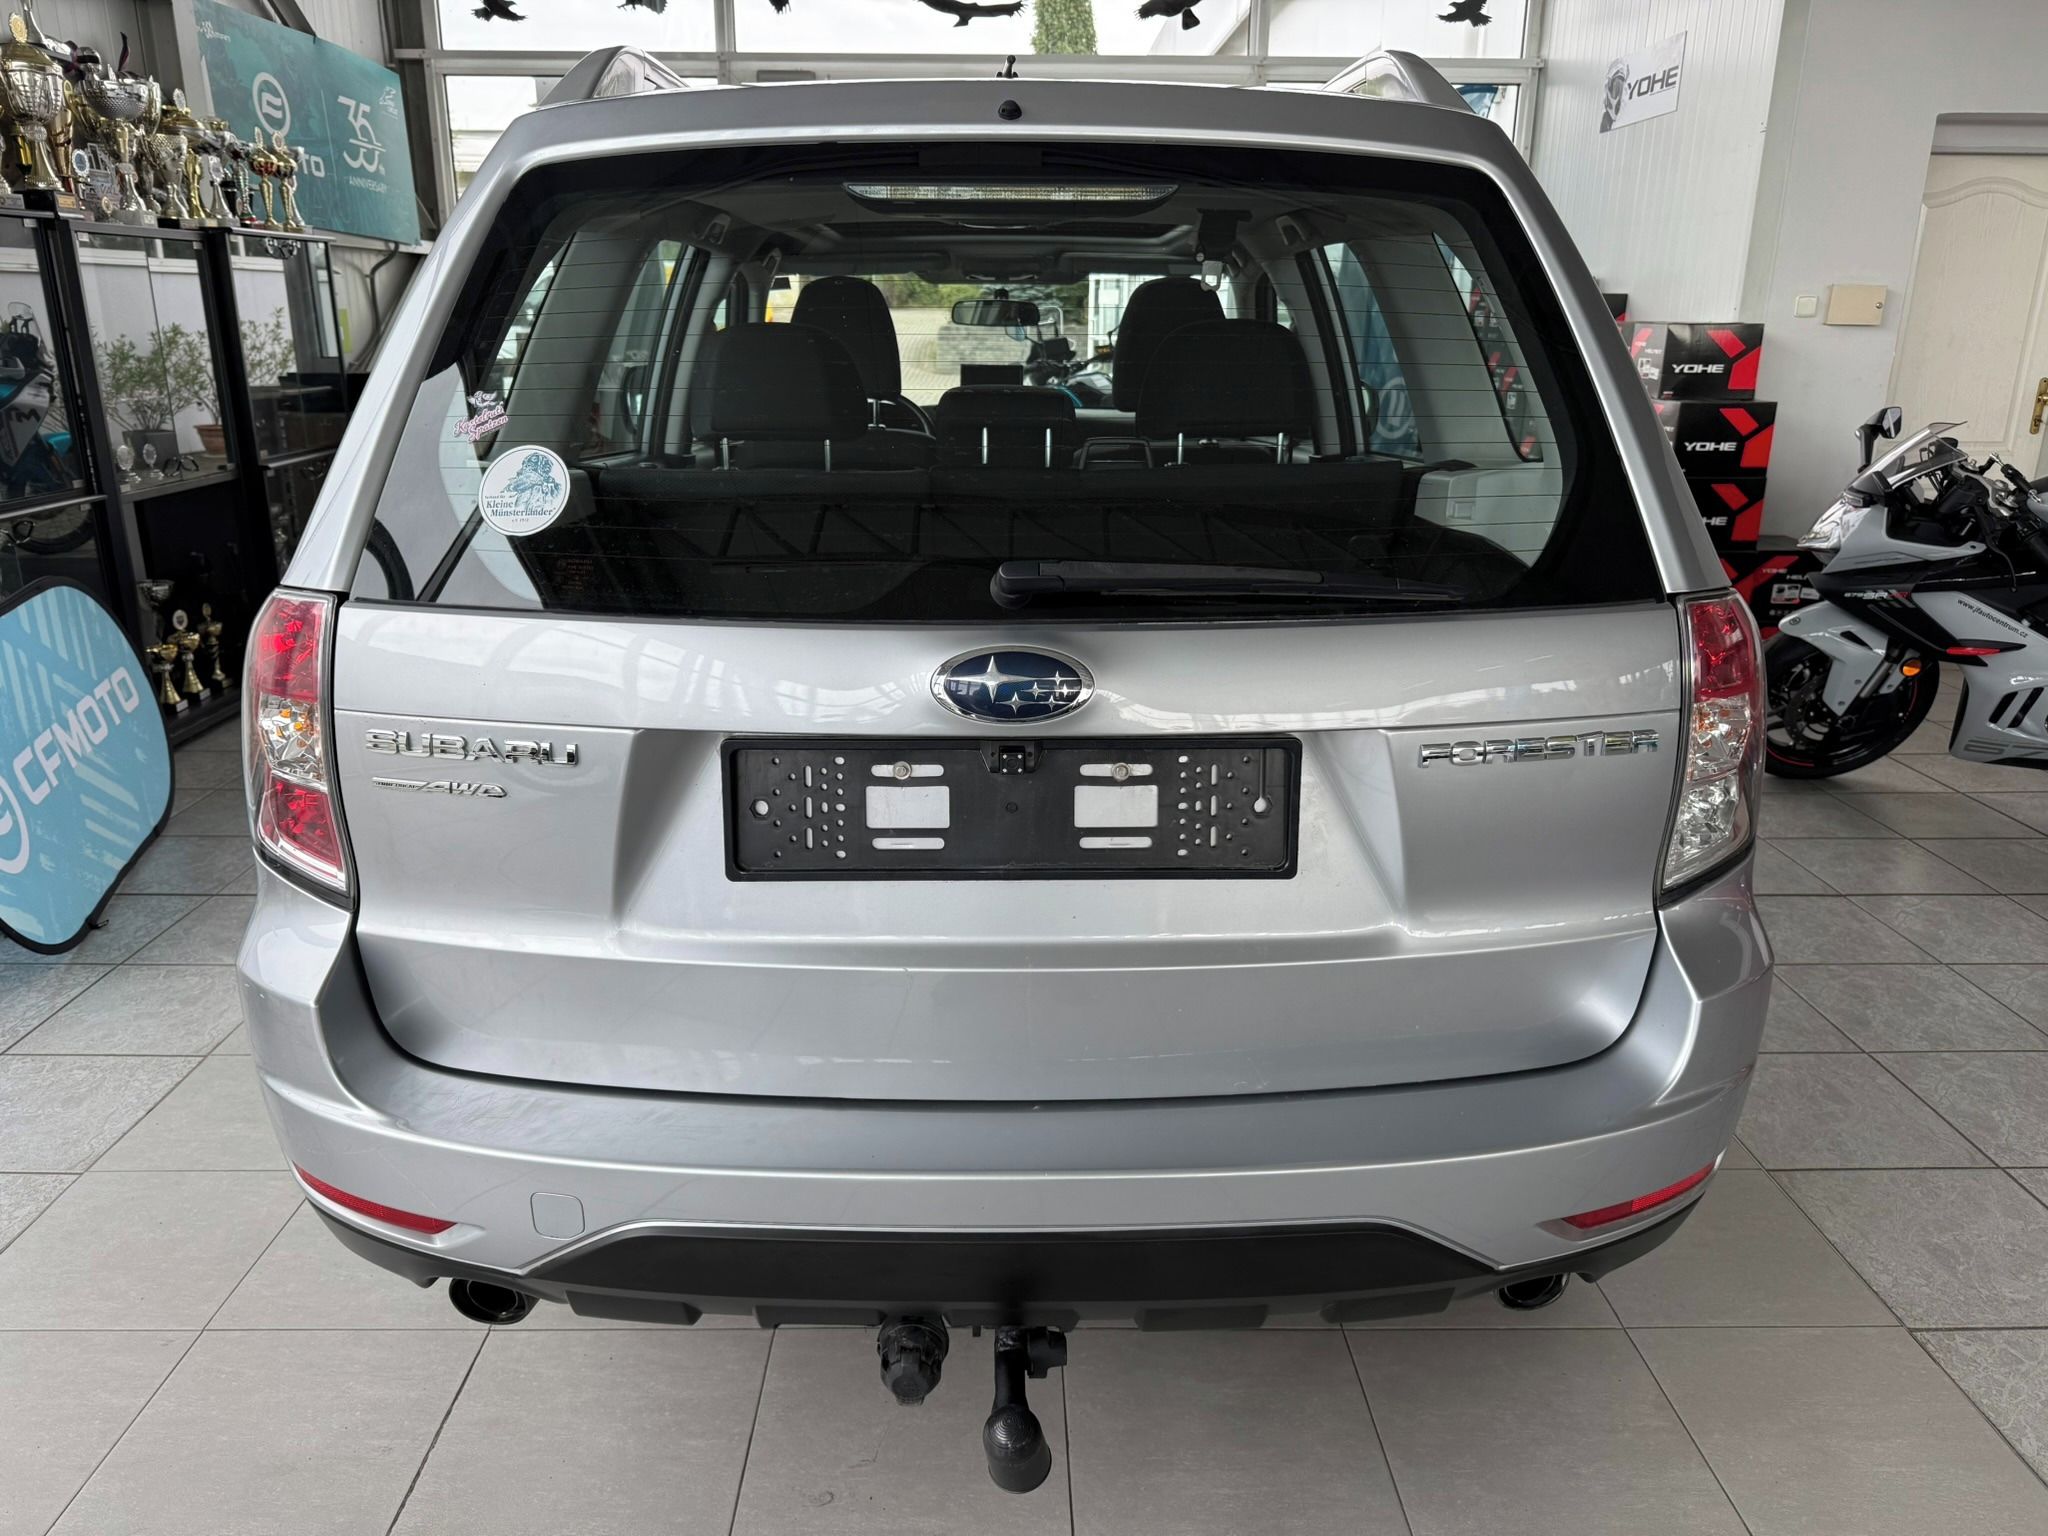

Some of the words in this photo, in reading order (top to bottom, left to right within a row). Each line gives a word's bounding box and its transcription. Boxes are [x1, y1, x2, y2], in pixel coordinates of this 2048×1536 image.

[1627, 65, 1679, 100] YOHE
[1672, 364, 1725, 373] YOHE
[1684, 442, 1737, 451] YOHE
[486, 500, 514, 509] Kleine
[490, 508, 553, 517] Münsterländer
[1702, 517, 1728, 526] HE
[1957, 598, 2029, 639] www.jfautocentrum.cz
[13, 666, 140, 805] CFMOTO
[365, 728, 579, 766] SUBARU
[1417, 728, 1660, 769] FORESTER
[418, 780, 508, 798] AWD
